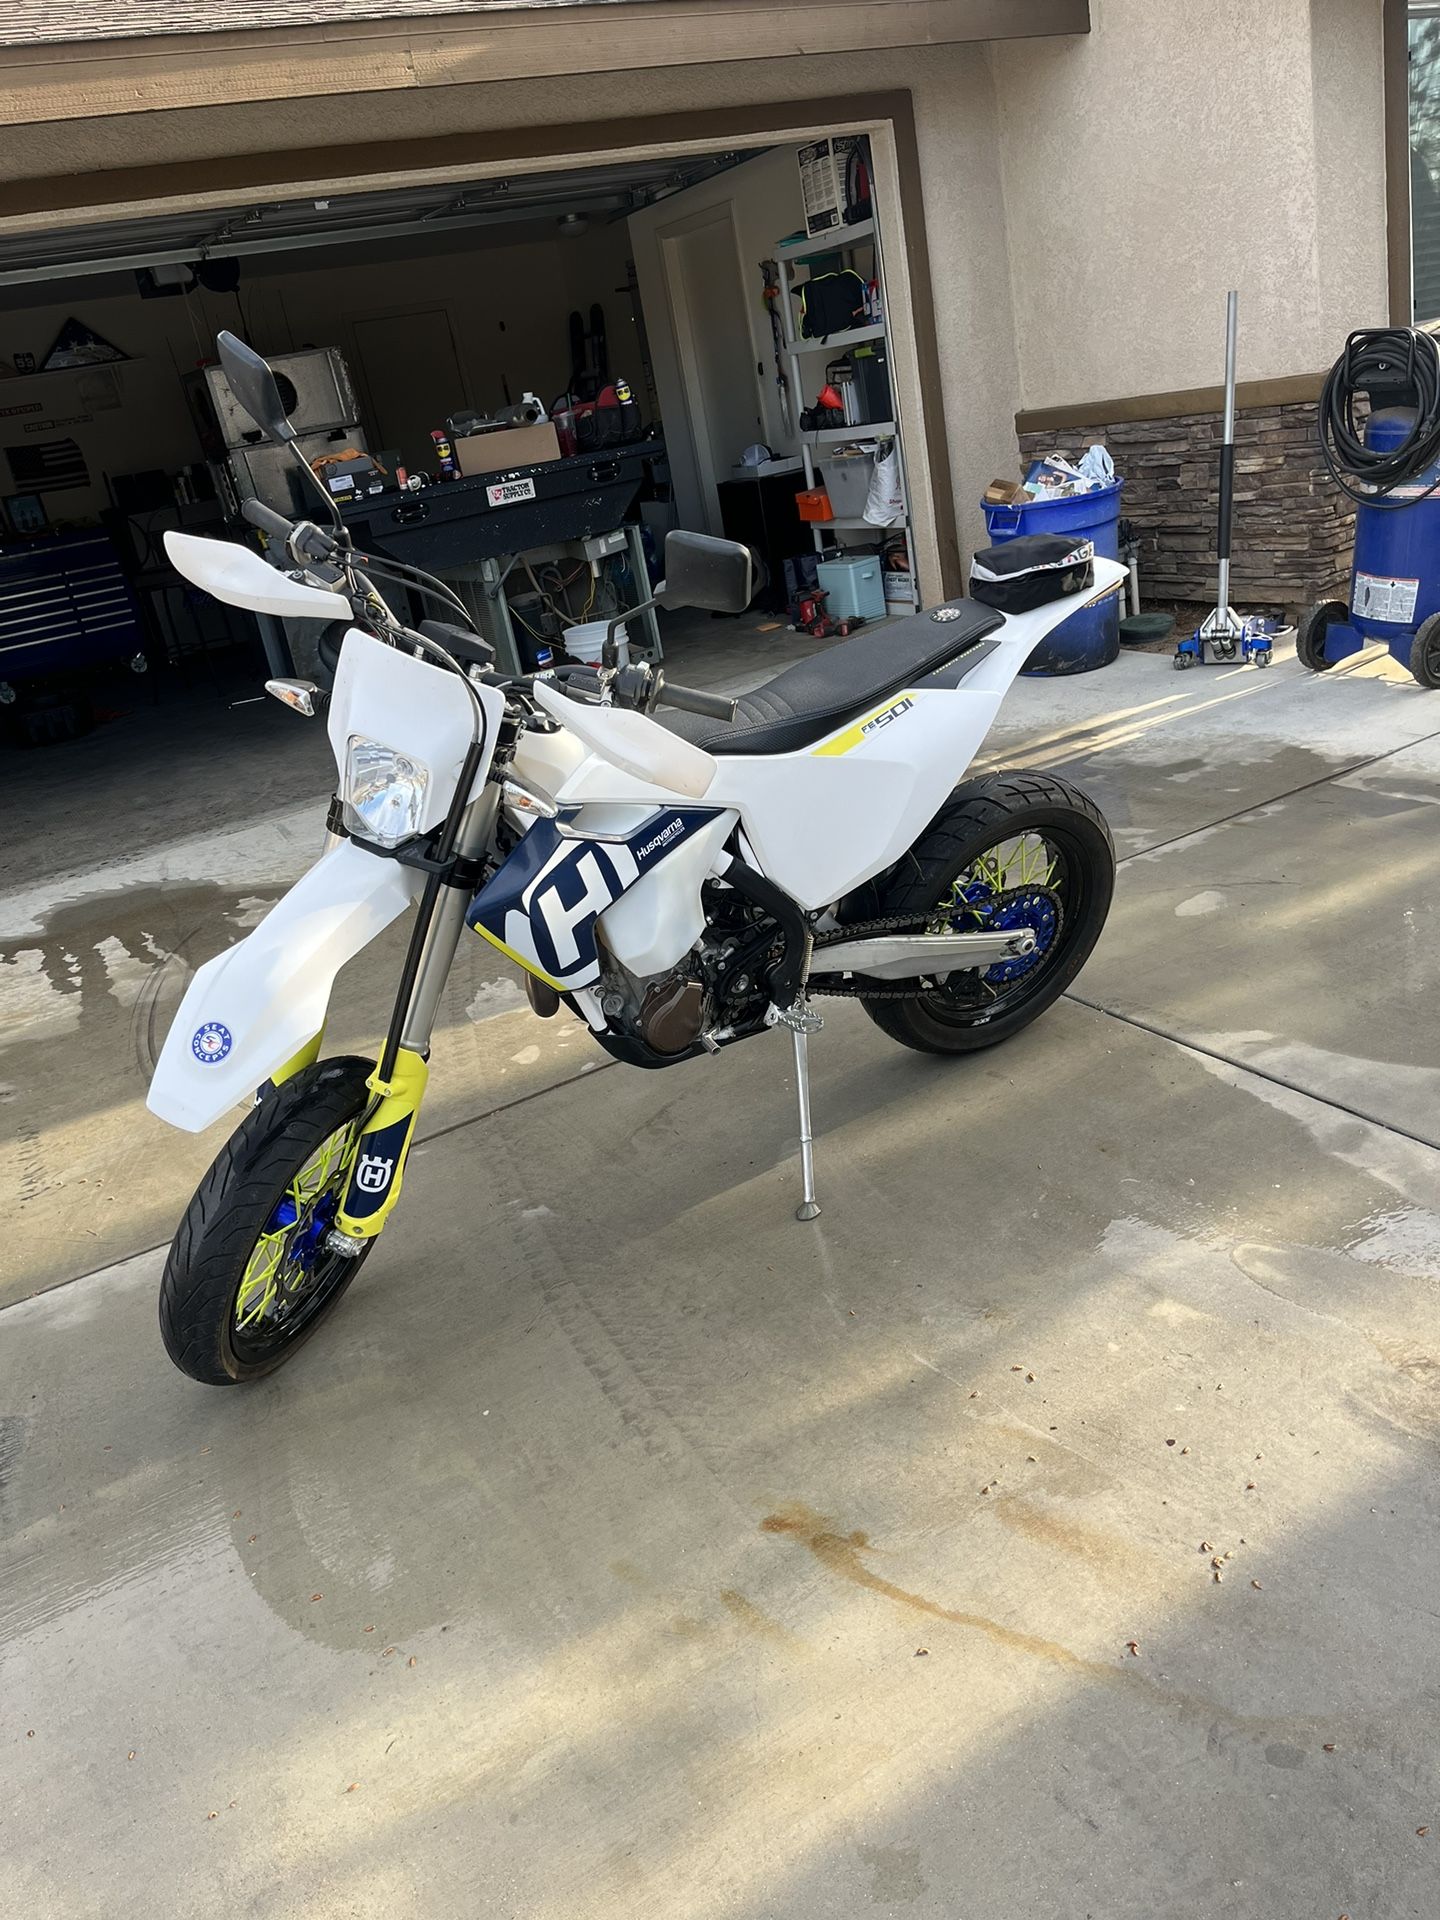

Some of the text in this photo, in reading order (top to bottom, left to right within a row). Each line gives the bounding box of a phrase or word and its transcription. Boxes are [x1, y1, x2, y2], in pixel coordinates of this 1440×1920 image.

[502, 482, 529, 493] TRACTOR
[503, 490, 524, 500] SUPPLY
[636, 817, 683, 861] Husqvarna
[203, 1024, 230, 1039] SEAT
[194, 1033, 229, 1061] CONCEPTS
